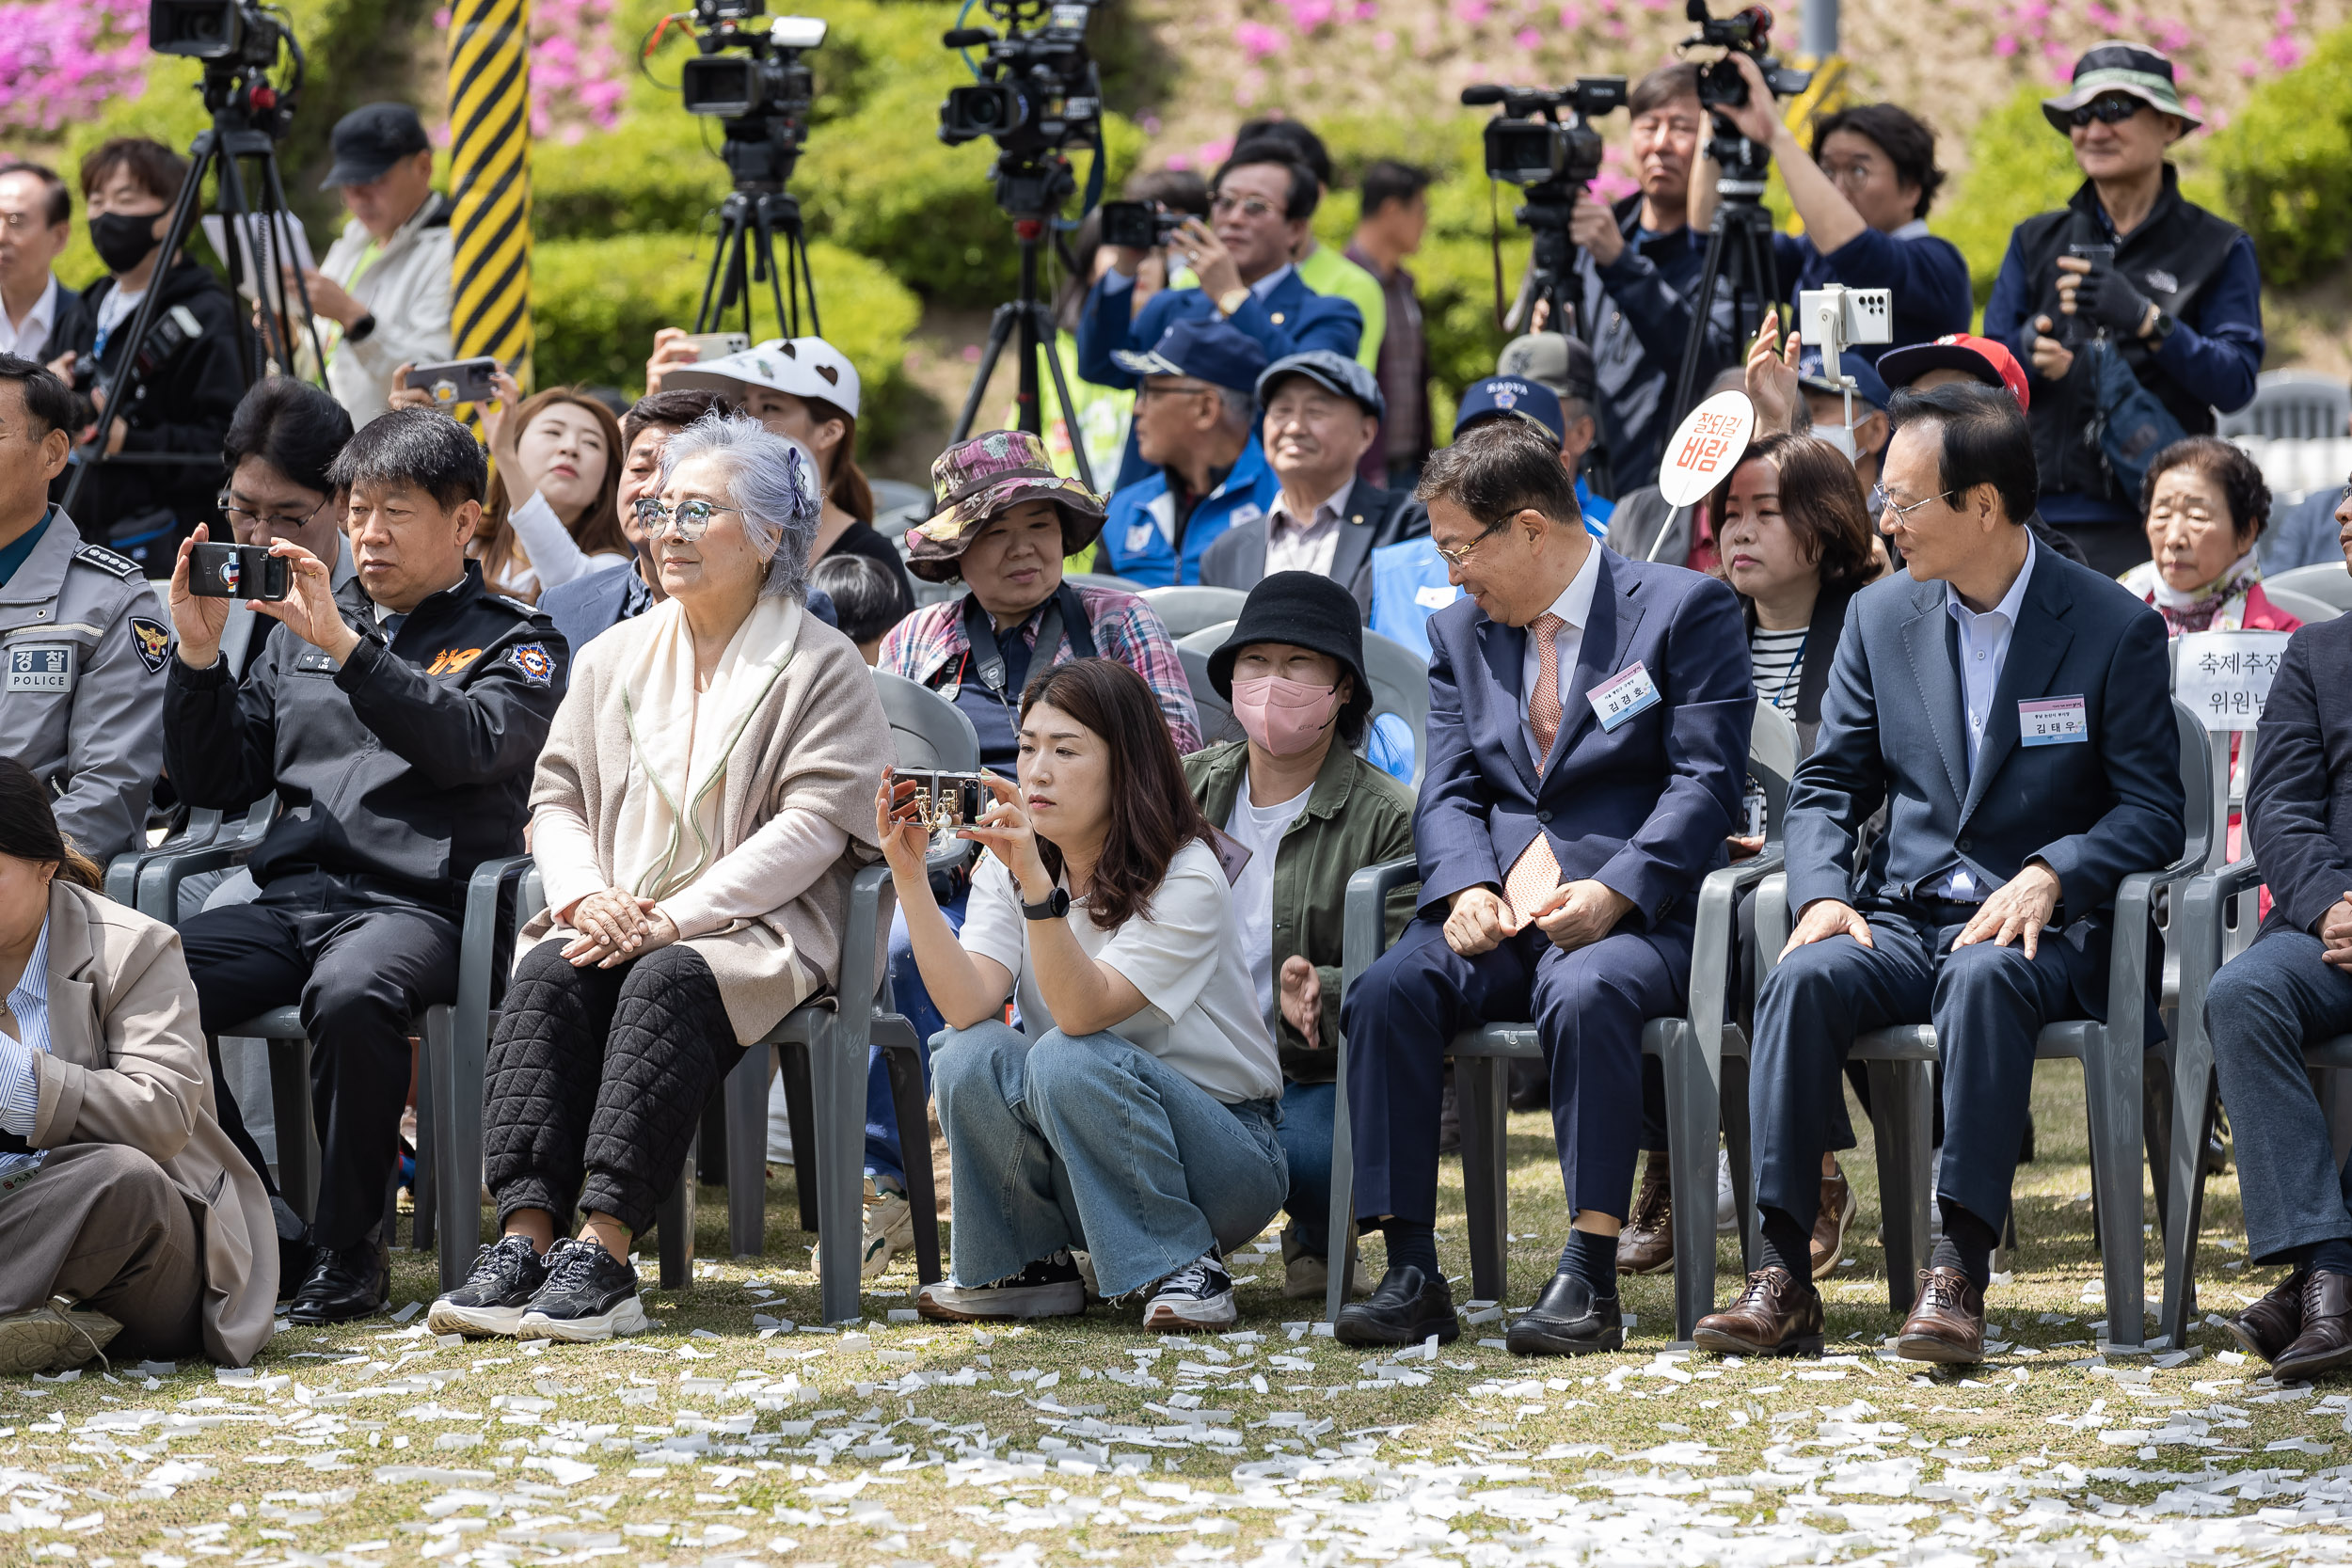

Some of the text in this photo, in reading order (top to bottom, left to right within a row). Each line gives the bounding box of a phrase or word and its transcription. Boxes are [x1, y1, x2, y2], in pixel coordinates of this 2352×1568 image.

[1693, 413, 1742, 438] 잘되길
[1677, 436, 1729, 472] 바람
[16, 651, 65, 672] 경찰
[146, 653, 161, 663] POLICE
[13, 675, 65, 686] POLICE
